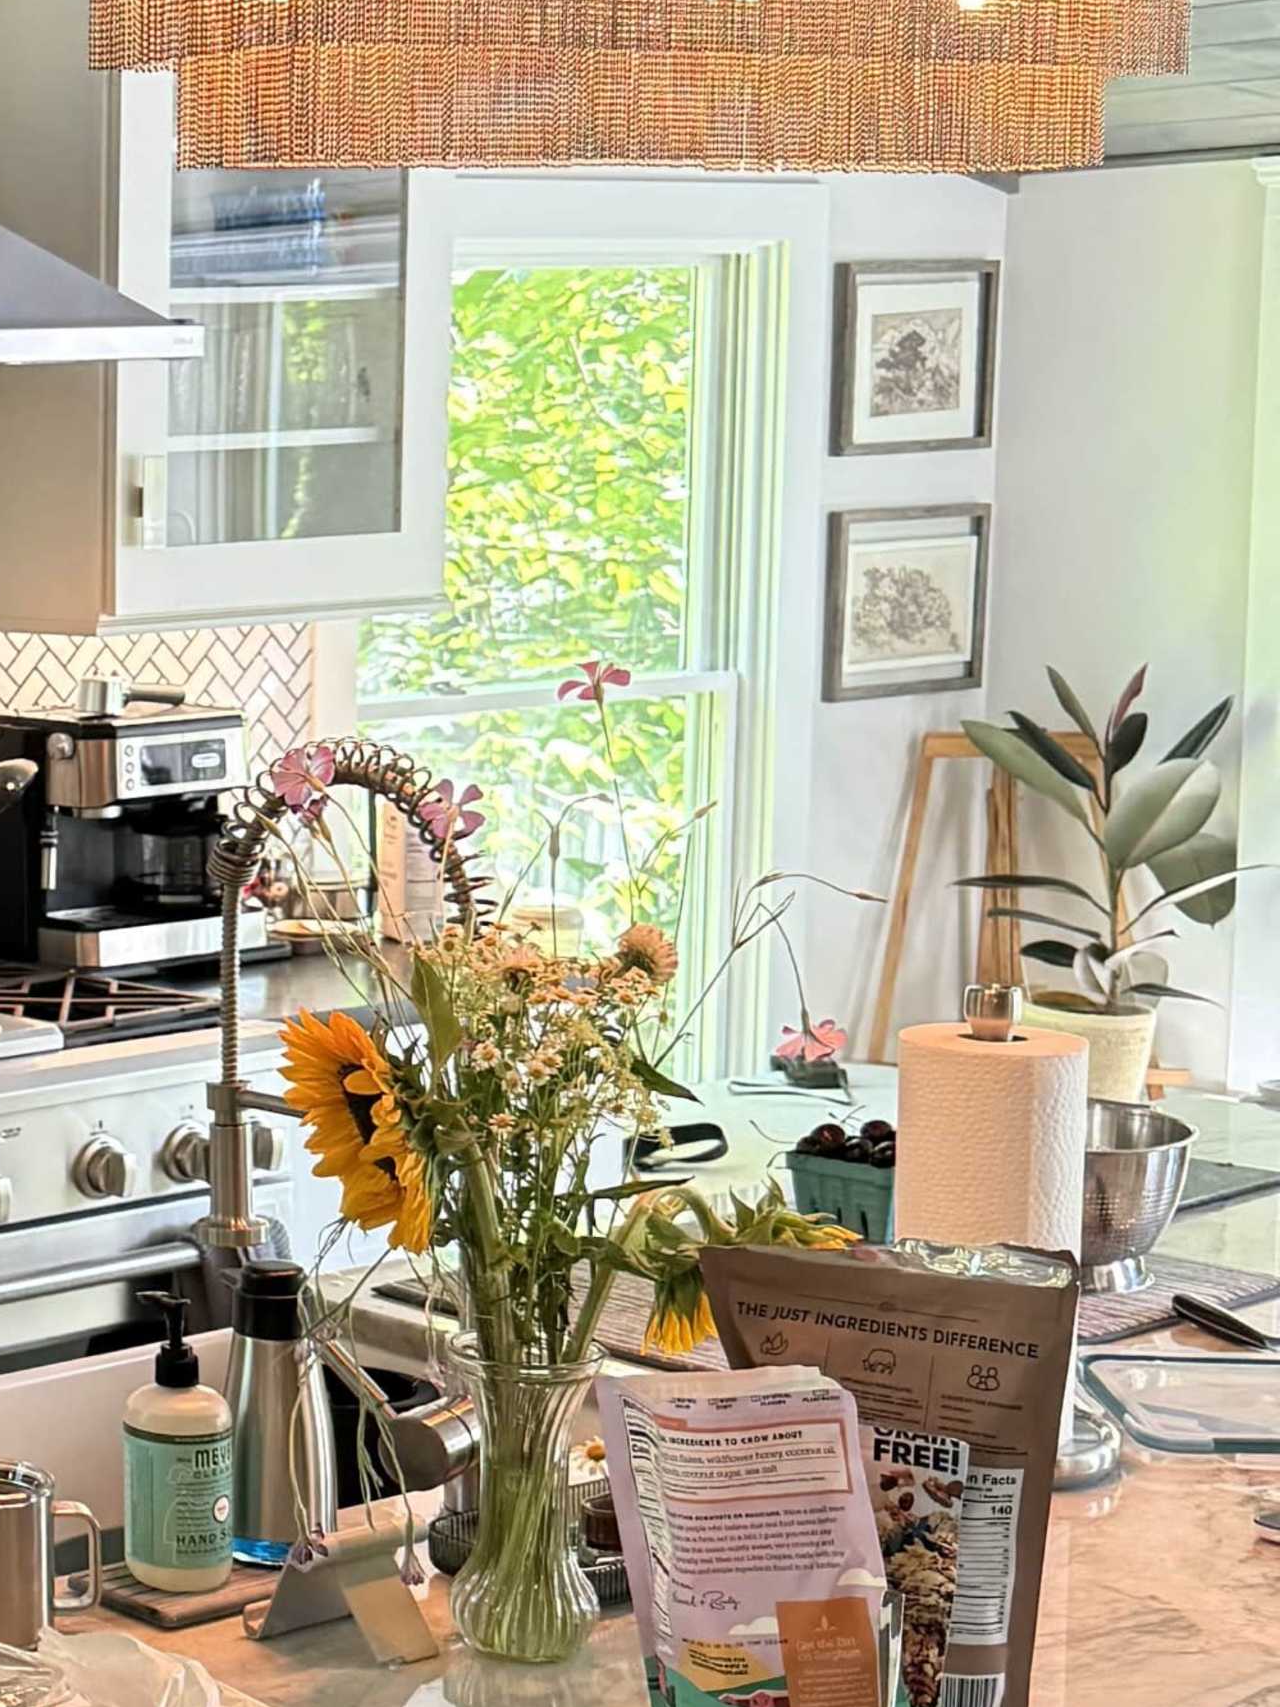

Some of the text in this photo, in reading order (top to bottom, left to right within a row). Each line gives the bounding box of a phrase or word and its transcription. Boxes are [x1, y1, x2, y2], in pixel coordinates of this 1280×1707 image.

[737, 1301, 1040, 1359] THE JUST INGREDIENTS DIFFERENCE
[873, 1437, 960, 1476] FREE!
[981, 1474, 1017, 1486] Facts
[990, 1504, 1013, 1516] 140
[176, 1534, 217, 1547] HAND
